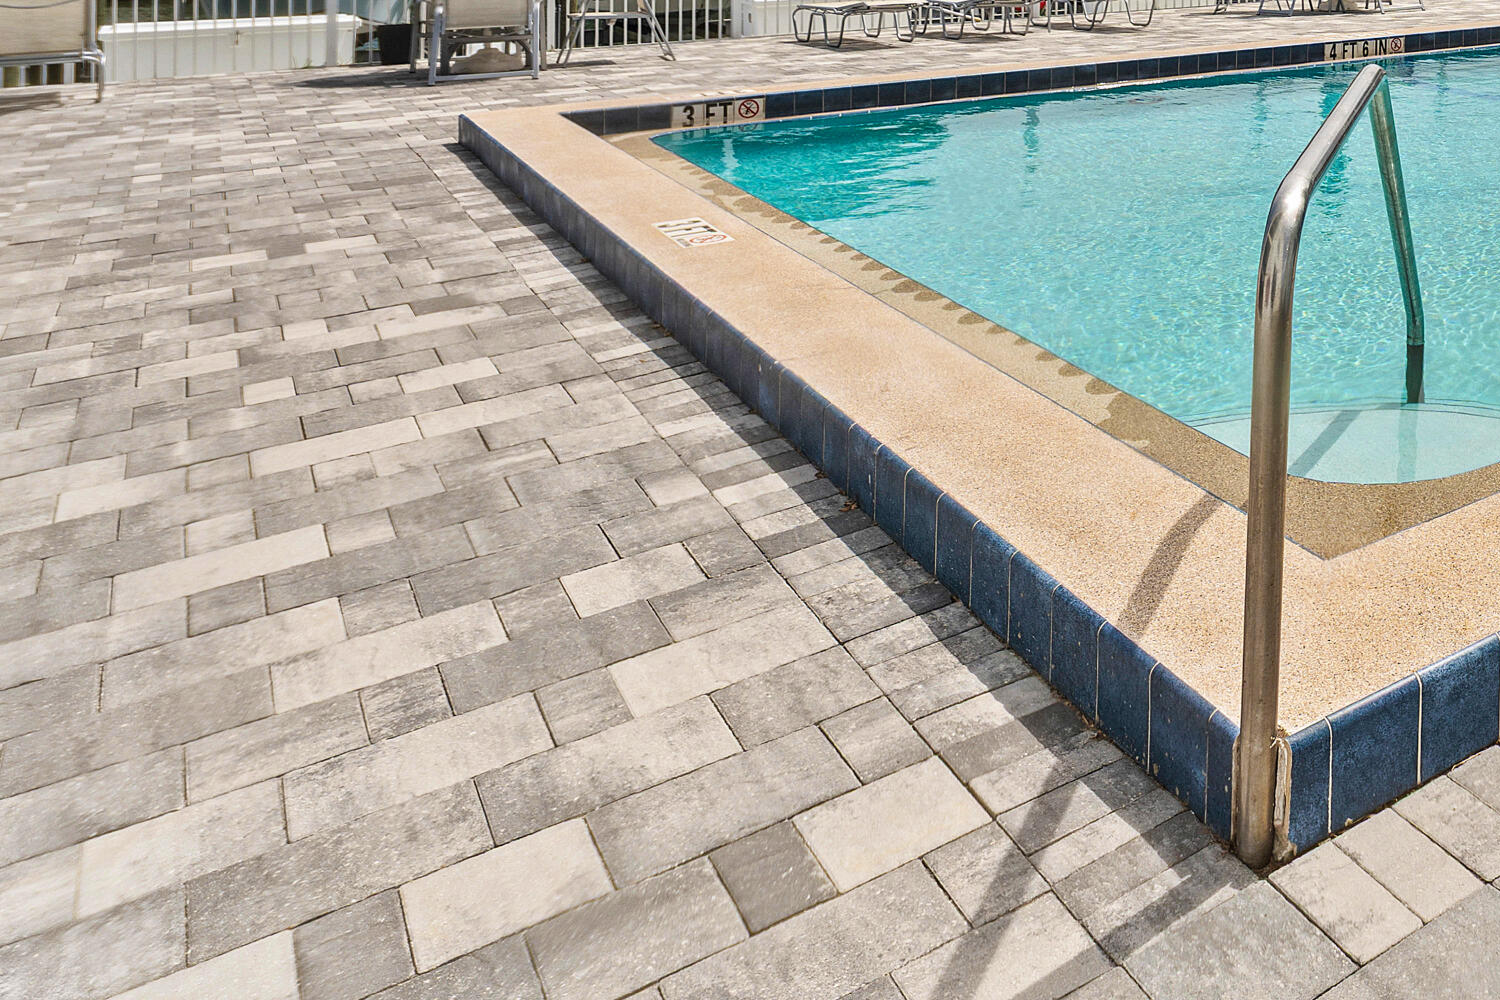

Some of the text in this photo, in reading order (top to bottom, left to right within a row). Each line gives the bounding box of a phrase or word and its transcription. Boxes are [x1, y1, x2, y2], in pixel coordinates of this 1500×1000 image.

[1329, 38, 1388, 60] 4 FT 6 IN
[682, 102, 733, 127] 3 FT
